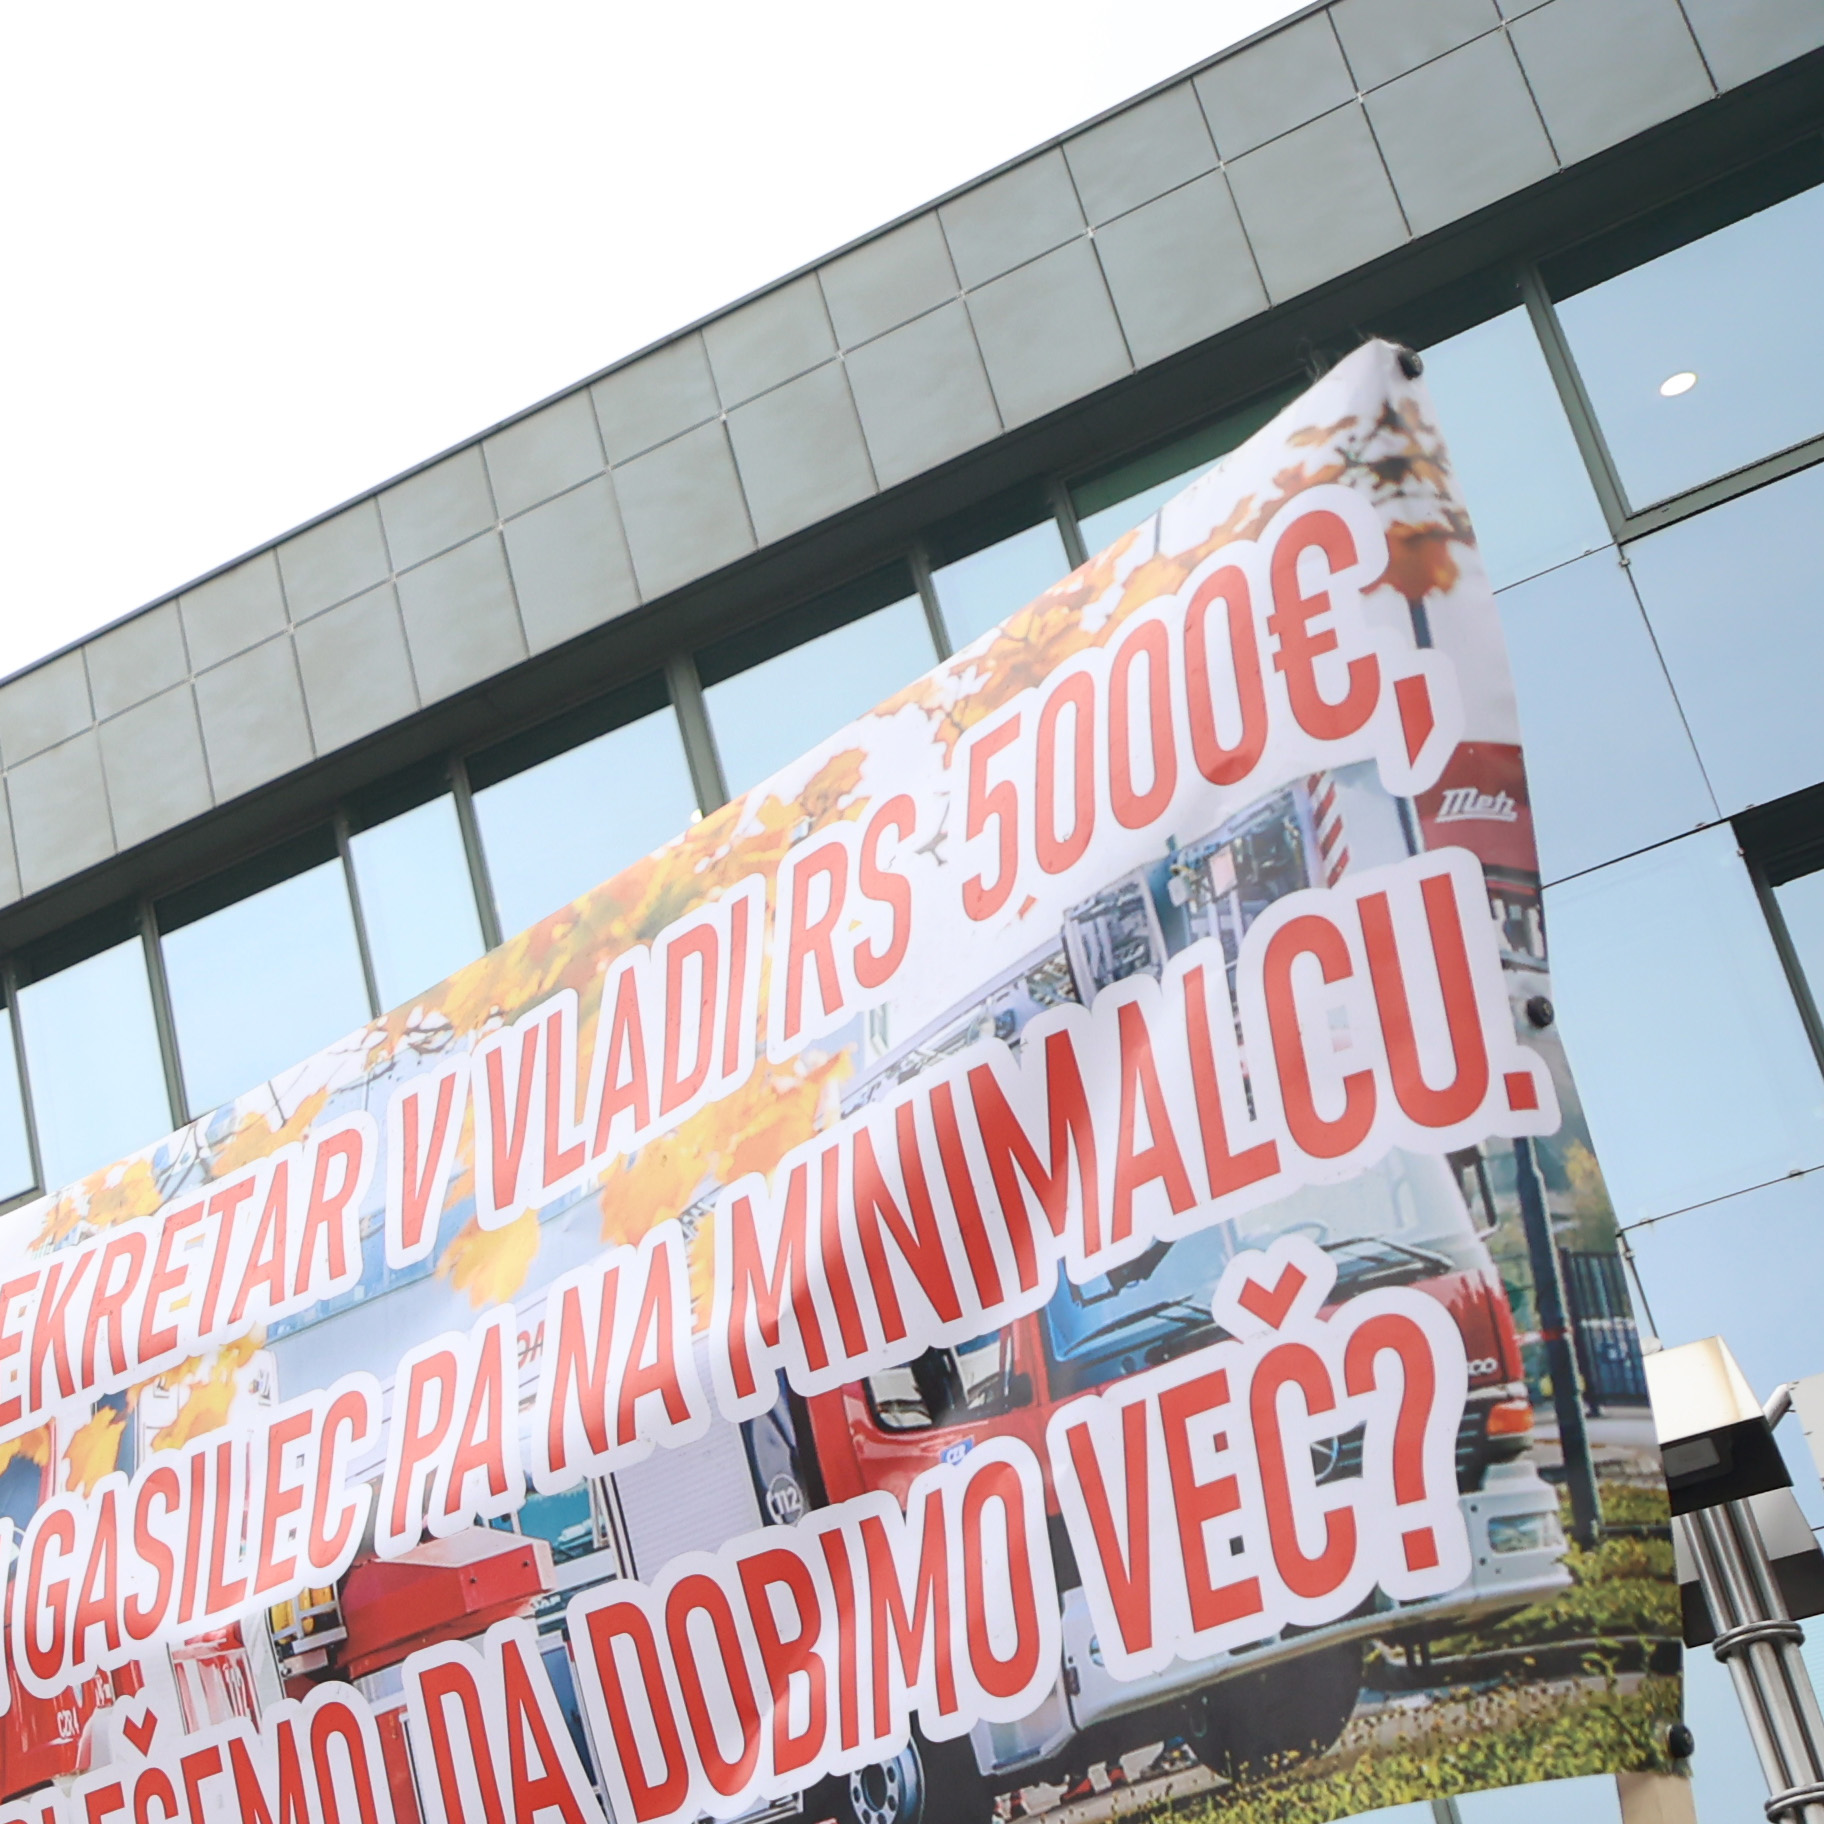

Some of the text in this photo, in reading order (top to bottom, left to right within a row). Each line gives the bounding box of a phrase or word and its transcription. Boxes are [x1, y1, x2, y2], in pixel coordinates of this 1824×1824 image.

[399, 1072, 457, 1252] V
[484, 894, 749, 1210] VLADI
[783, 793, 917, 1042] RS
[22, 1389, 368, 1680] GASILEC
[390, 1323, 509, 1538] PA
[548, 1239, 691, 1473] NA
[726, 871, 1540, 1400] MINIMALCU.
[1065, 1260, 1441, 1656] VEČ?
